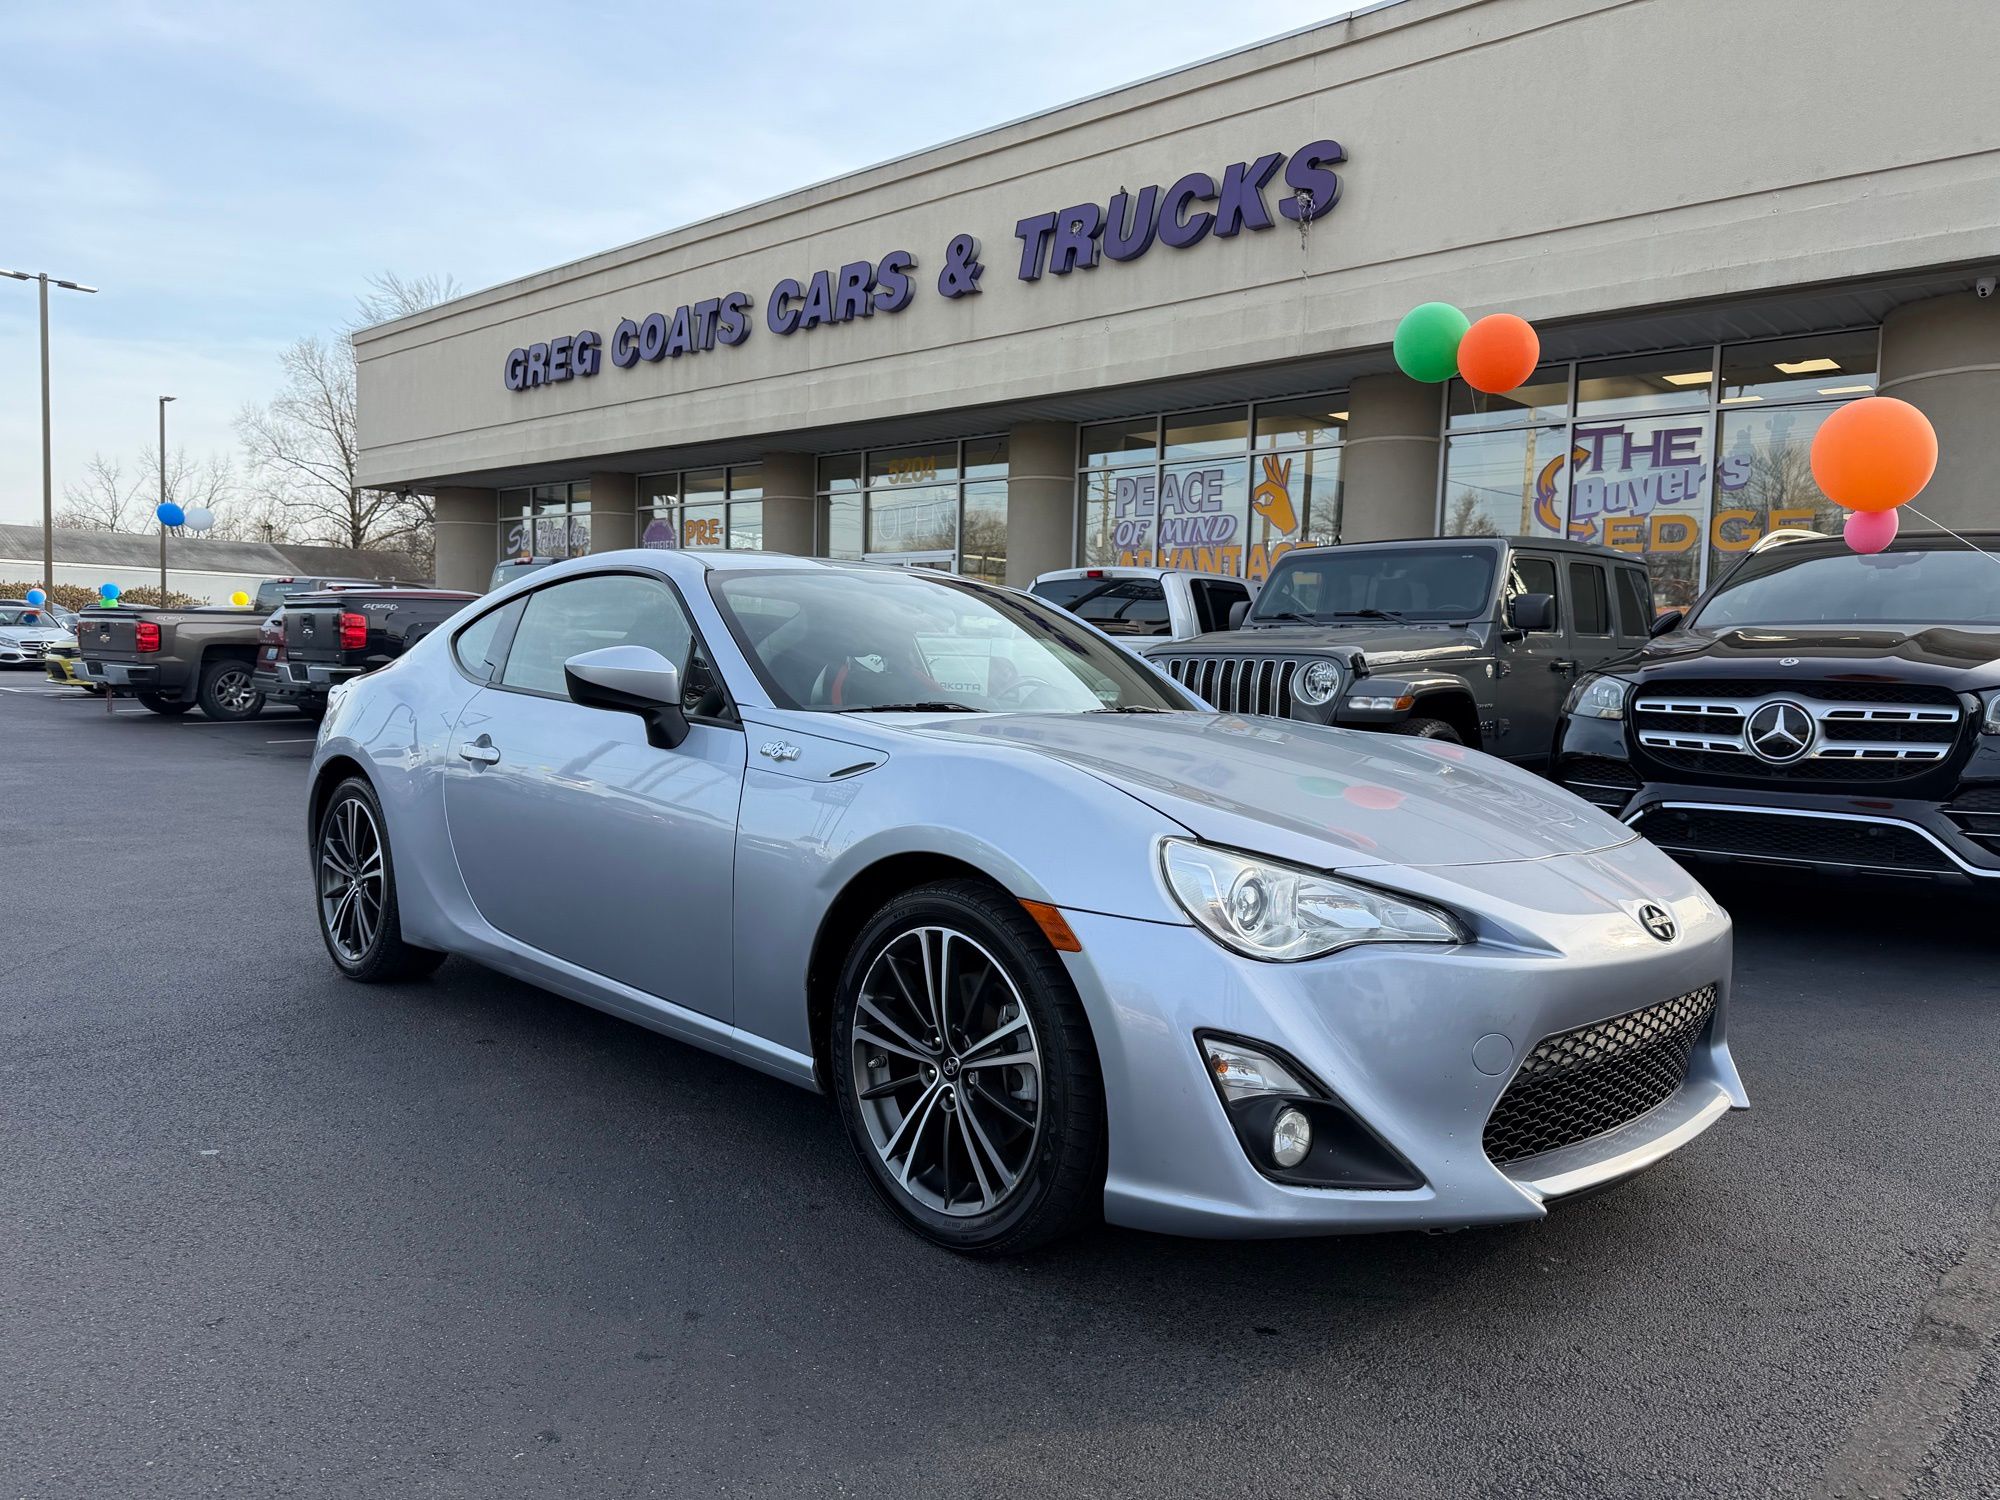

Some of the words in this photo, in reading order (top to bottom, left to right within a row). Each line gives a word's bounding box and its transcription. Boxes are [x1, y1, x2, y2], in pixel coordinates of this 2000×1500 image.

[504, 330, 601, 391] GREG
[611, 291, 753, 369] COATS
[767, 249, 918, 335] CARS
[938, 234, 986, 299] &
[1016, 139, 1347, 282] TRUCKS
[1574, 424, 1703, 473] THE
[1115, 469, 1223, 518] PEACE
[506, 524, 531, 555] Se
[537, 518, 589, 548] Habla
[684, 518, 723, 546] PRE-
[878, 501, 950, 539] OPEN
[1113, 520, 1151, 549] OF
[1159, 515, 1238, 547] MIND
[1602, 508, 1816, 553] EDGE
[1119, 541, 1318, 584] VANTA
